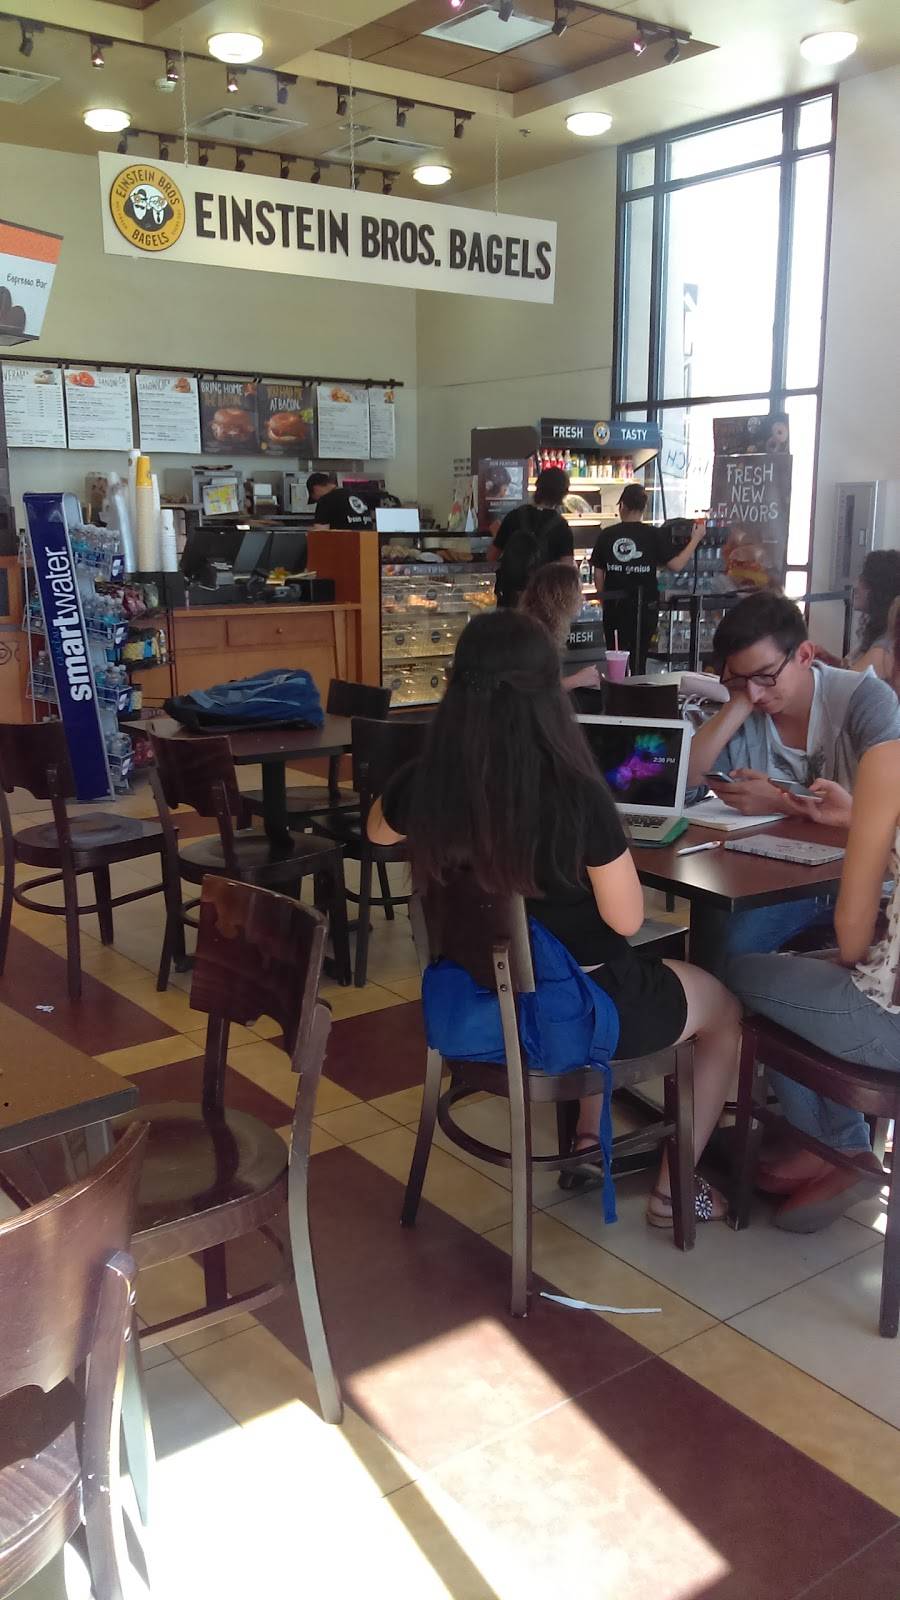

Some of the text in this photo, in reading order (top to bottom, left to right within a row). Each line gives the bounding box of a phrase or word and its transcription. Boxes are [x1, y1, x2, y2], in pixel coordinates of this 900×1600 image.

[116, 170, 179, 205] EINSTEIN BROS
[132, 230, 169, 246] BAGELS
[195, 191, 349, 257] EINSTEIN
[361, 216, 441, 267] BROS.
[449, 228, 552, 280] BAGELS
[7, 273, 48, 288] Espresso Bar
[201, 382, 244, 396] BRING HOME
[278, 399, 301, 411] BACON
[553, 426, 583, 439] FRESH
[621, 429, 647, 441] TASTY
[727, 463, 773, 485] FRESH
[732, 485, 765, 503] NEW
[625, 564, 650, 575] genius
[45, 546, 93, 702] smartwater
